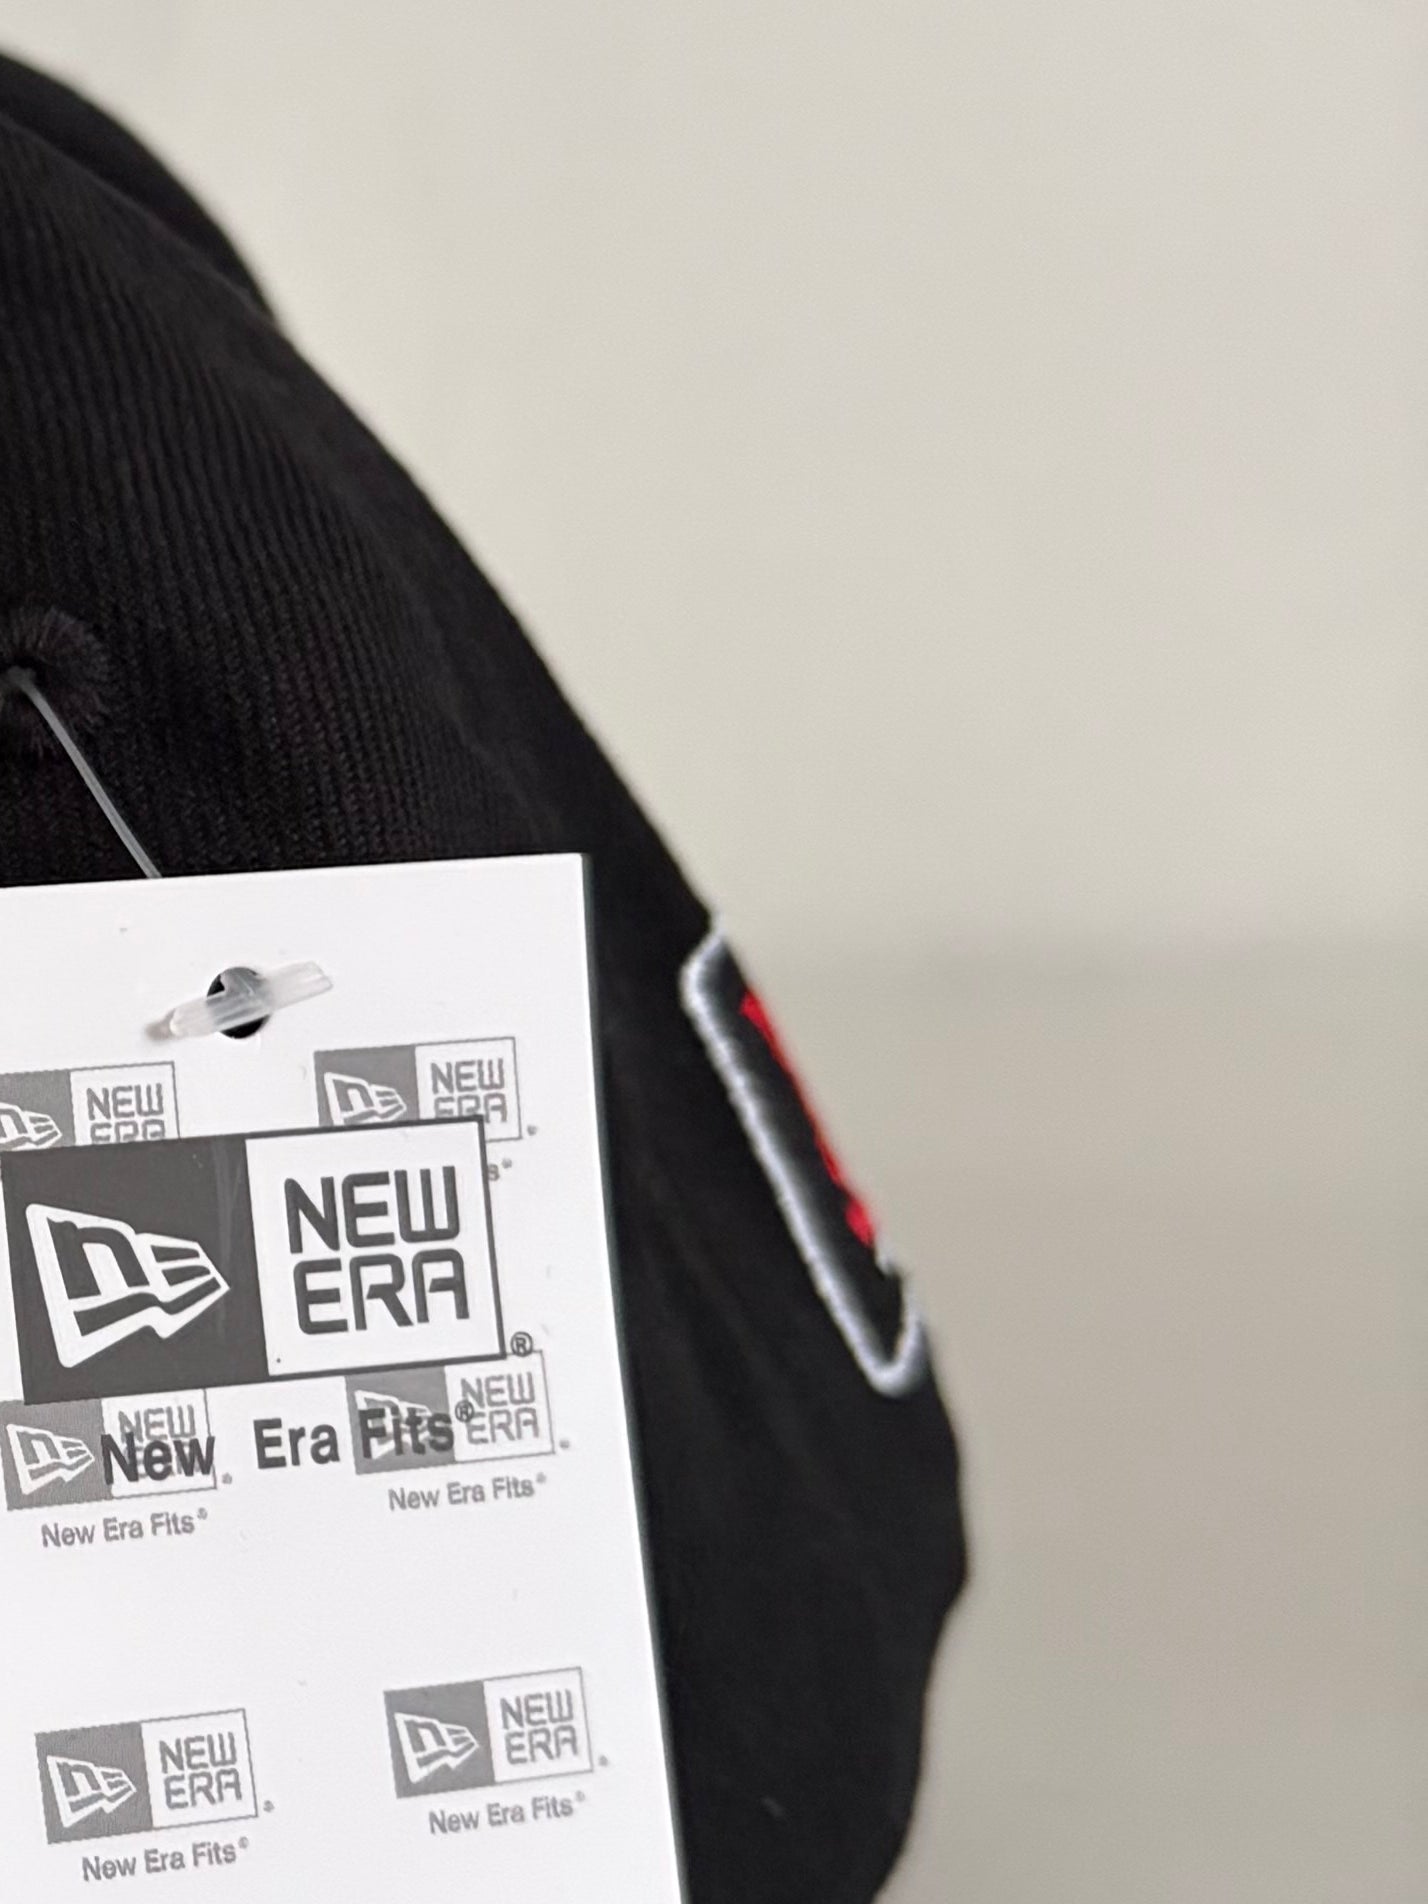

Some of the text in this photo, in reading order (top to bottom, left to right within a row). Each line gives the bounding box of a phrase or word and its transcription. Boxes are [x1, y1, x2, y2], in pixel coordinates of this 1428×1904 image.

[431, 1058, 505, 1094] NEW
[86, 1083, 164, 1120] NEW
[284, 1166, 460, 1254] NEW
[293, 1248, 469, 1335] ERA
[460, 1371, 536, 1409] NEW
[118, 1404, 196, 1443] NEW
[465, 1406, 540, 1445] ERA
[100, 1431, 216, 1485] New
[253, 1417, 340, 1470] Era
[388, 1487, 440, 1511] New
[446, 1482, 485, 1505] Era
[41, 1523, 95, 1547] New
[103, 1517, 144, 1542] Era
[500, 1688, 574, 1730] NEW
[159, 1731, 237, 1774] NEW
[504, 1725, 578, 1765] ERA
[164, 1768, 242, 1810] ERA
[428, 1810, 480, 1835] New
[487, 1803, 525, 1827] Era
[82, 1856, 137, 1882] New
[145, 1849, 186, 1874] Era
